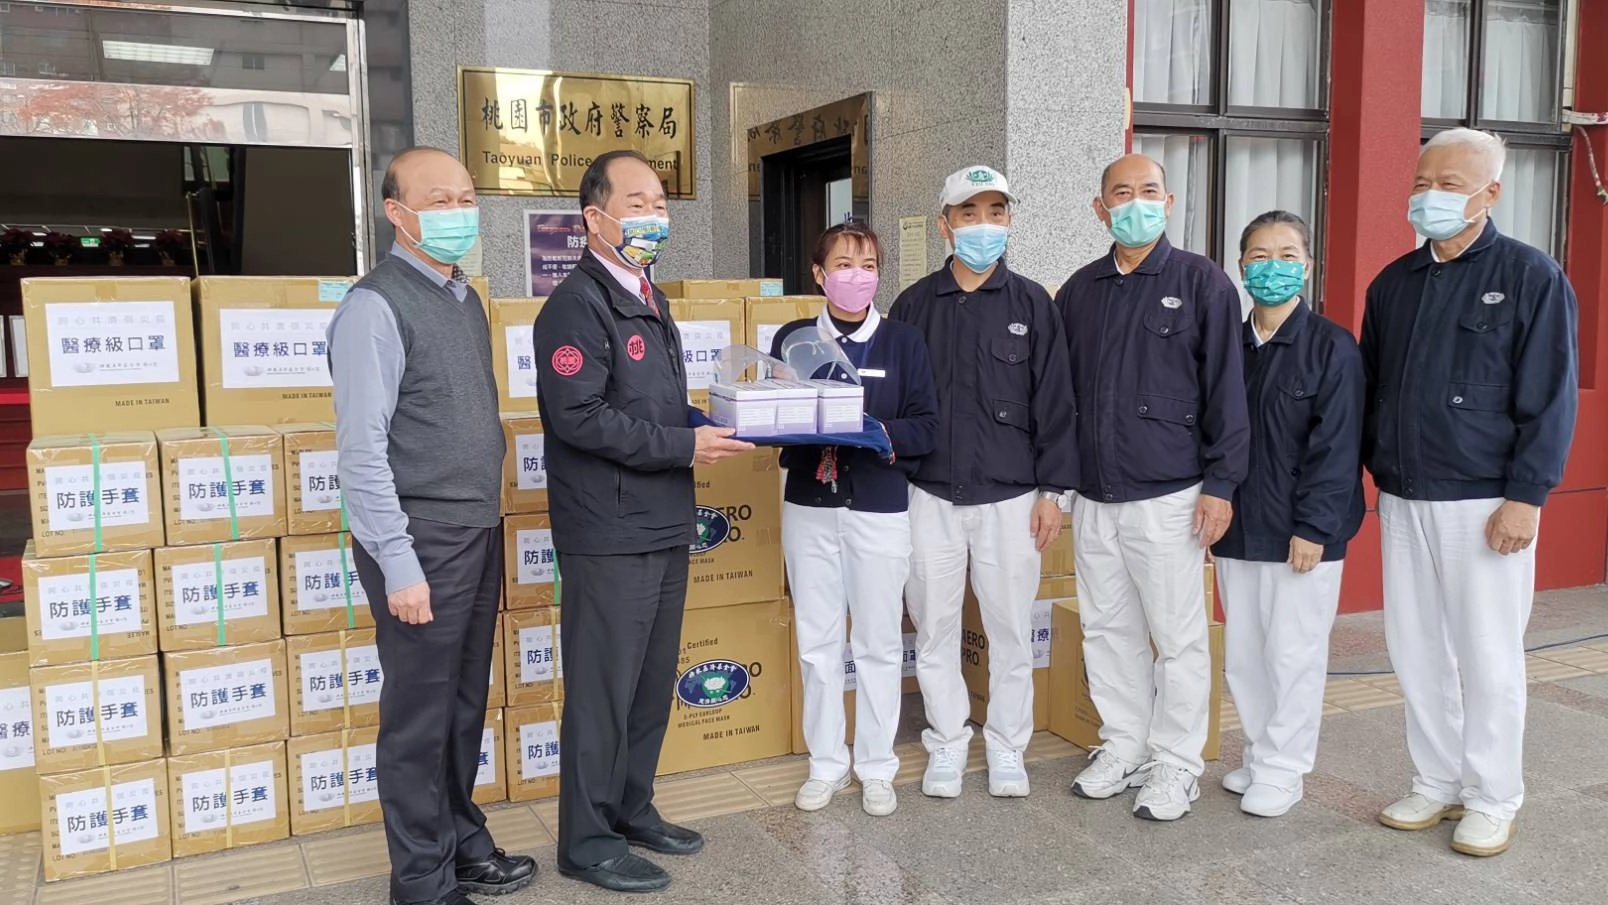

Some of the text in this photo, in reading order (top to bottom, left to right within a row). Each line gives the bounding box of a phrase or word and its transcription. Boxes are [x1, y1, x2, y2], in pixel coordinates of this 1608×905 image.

[481, 97, 677, 140] 桃園市政府警察局
[483, 151, 678, 170] Taoyuan Police ment
[61, 334, 166, 354] 醫療級口罩
[233, 341, 328, 358] 醫療級口罩
[57, 487, 140, 510] 防護手套
[188, 479, 266, 500] 防護手套
[693, 574, 714, 583] MADE
[726, 570, 753, 580] TAIWAN
[49, 594, 132, 619] 防護手套
[687, 637, 719, 650] Certified
[310, 668, 380, 692] 防護手套
[190, 682, 267, 709] 防護手套
[56, 701, 138, 728] 防護手套
[677, 720, 701, 729] MEDICAL
[703, 724, 760, 740] MADE IN TAIWAN
[67, 804, 149, 833] 防護手套
